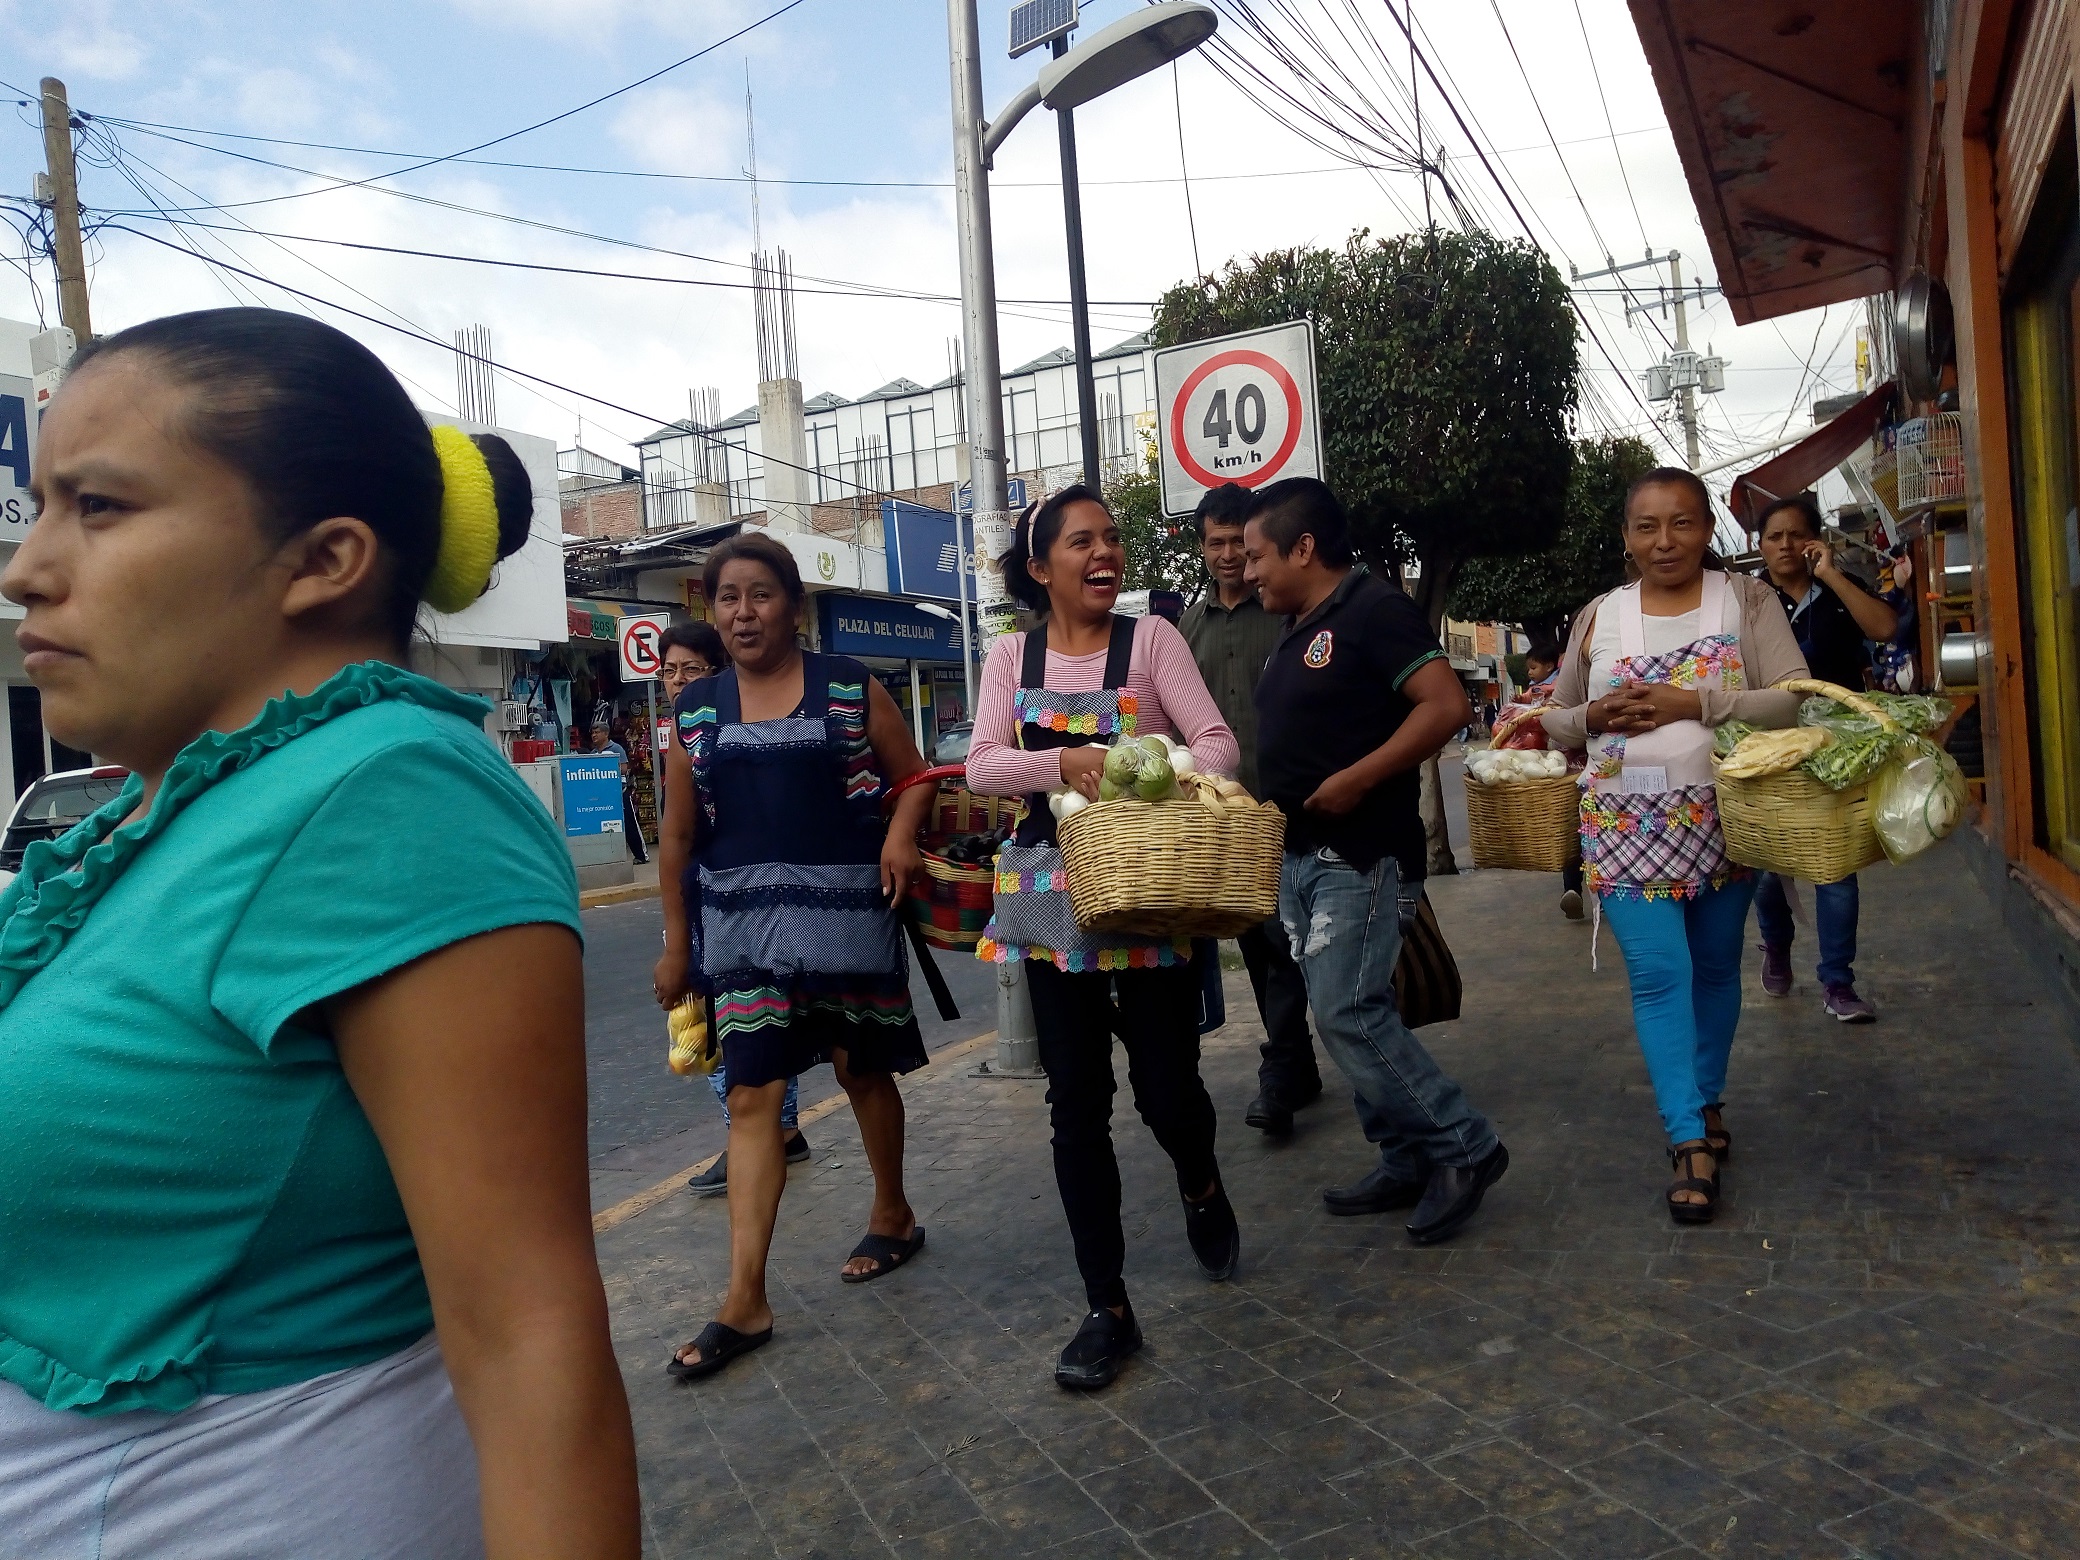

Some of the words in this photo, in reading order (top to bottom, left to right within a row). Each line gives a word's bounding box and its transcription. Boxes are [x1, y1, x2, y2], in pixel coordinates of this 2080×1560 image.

[1203, 383, 1267, 448] 40
[1213, 450, 1263, 469] km/h
[838, 617, 871, 635] PLAZA
[873, 620, 893, 637] DEL
[894, 622, 936, 640] CELULAR
[566, 768, 618, 781] infinitum
